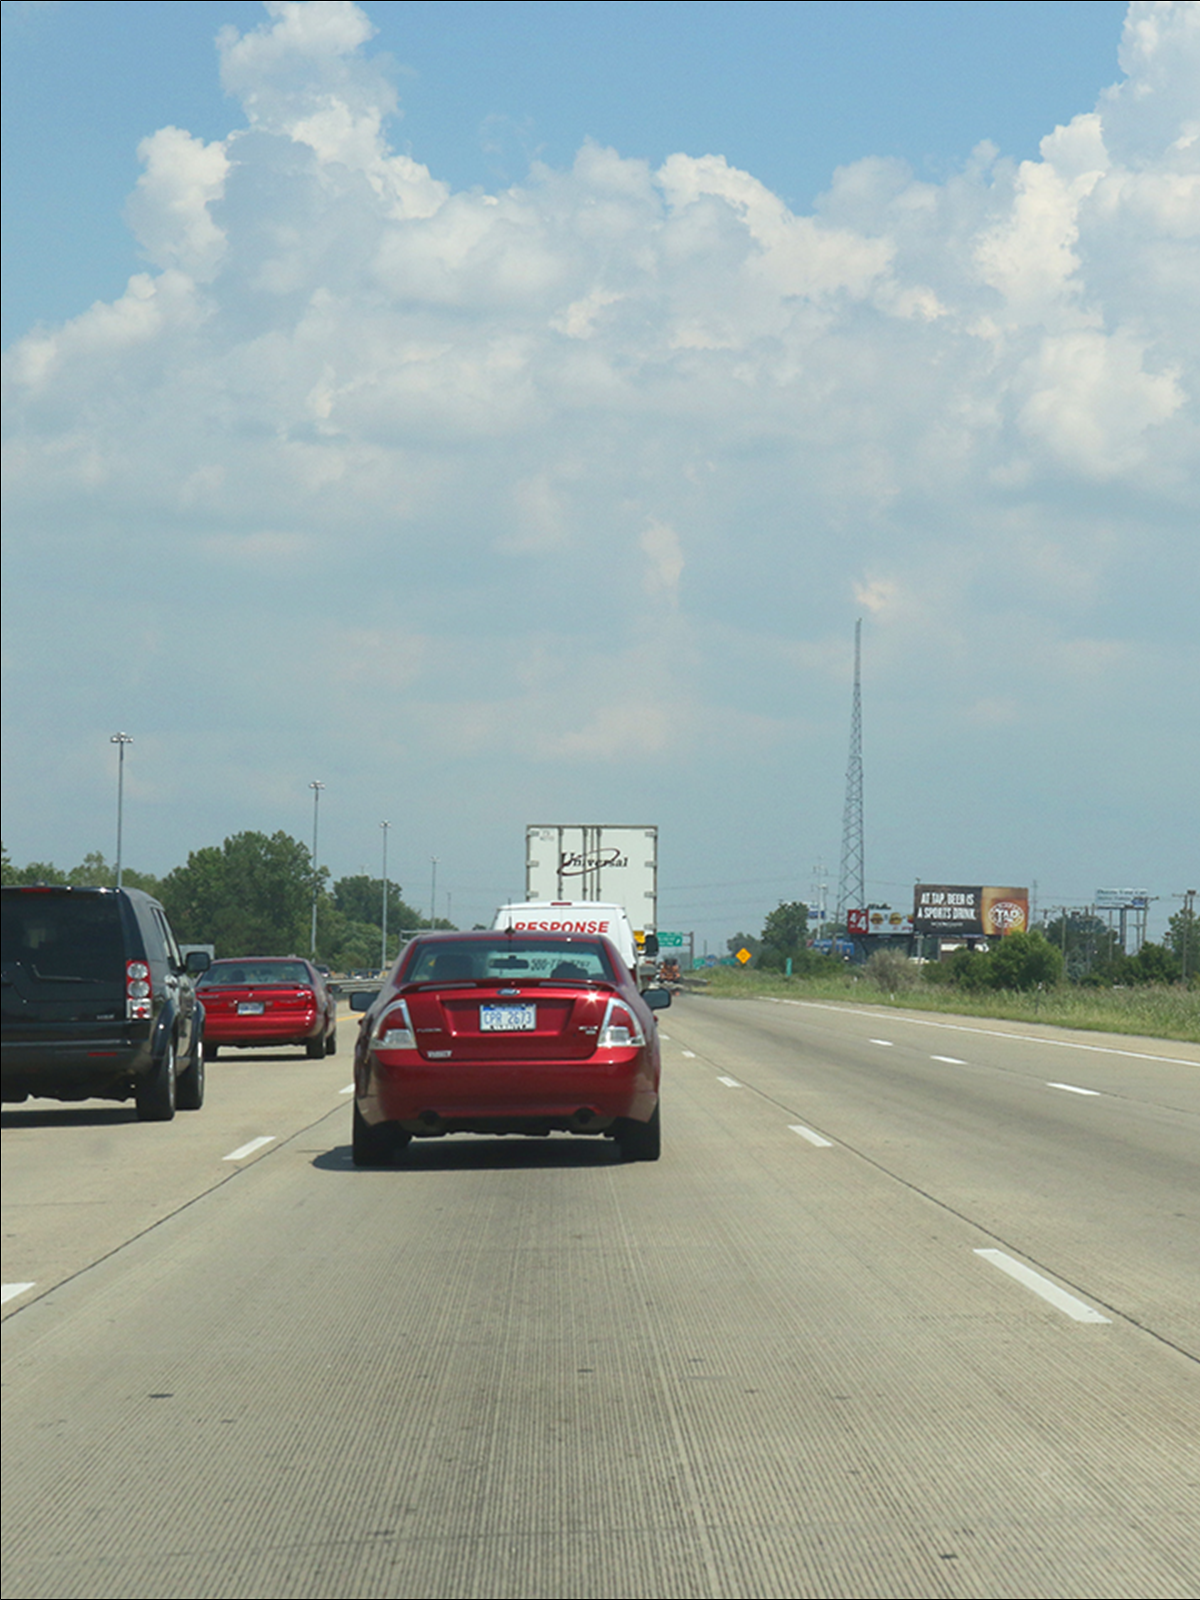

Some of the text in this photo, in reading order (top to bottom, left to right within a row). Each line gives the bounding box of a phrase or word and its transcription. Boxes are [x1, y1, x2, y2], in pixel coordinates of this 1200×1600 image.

[561, 852, 628, 867] Universal
[921, 892, 930, 904] AT
[947, 893, 965, 905] BEER
[966, 893, 975, 906] IS
[917, 907, 923, 918] A
[924, 907, 951, 919] SPORTS
[515, 921, 610, 934] RESPONSE
[484, 1011, 532, 1025] CPR 2673
